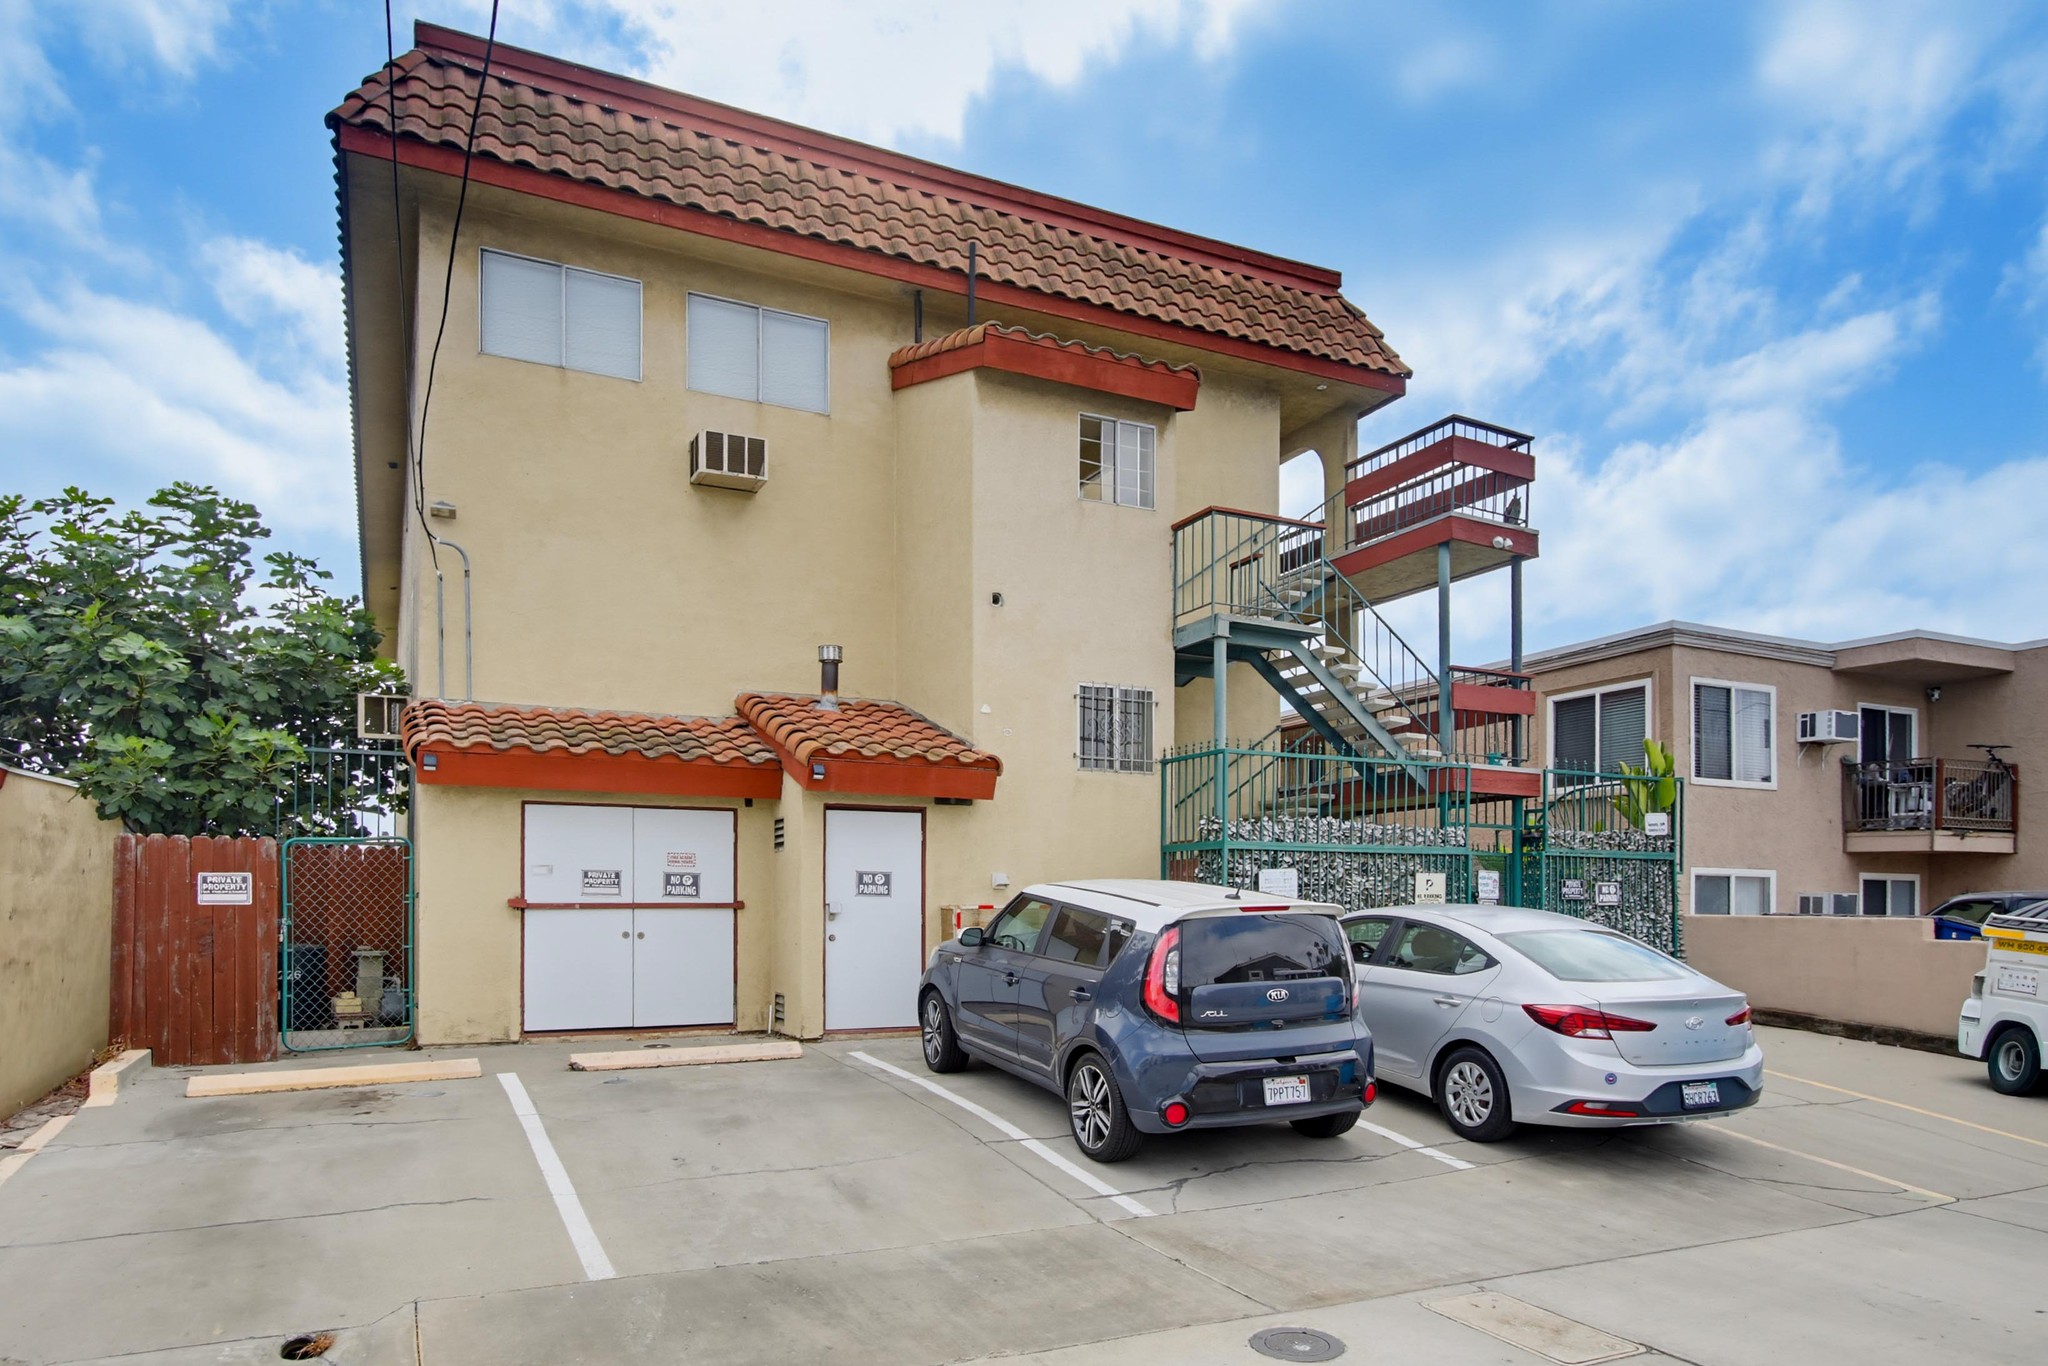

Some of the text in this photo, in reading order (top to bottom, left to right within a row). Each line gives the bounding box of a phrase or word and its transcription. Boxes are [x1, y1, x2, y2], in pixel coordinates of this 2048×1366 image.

[670, 875, 681, 884] NO
[862, 874, 873, 884] NO
[666, 885, 697, 895] PARKING
[859, 884, 889, 894] PARKING
[1602, 885, 1609, 893] NO
[1270, 990, 1287, 1000] KIA
[1267, 1086, 1306, 1101] 7PPT757
